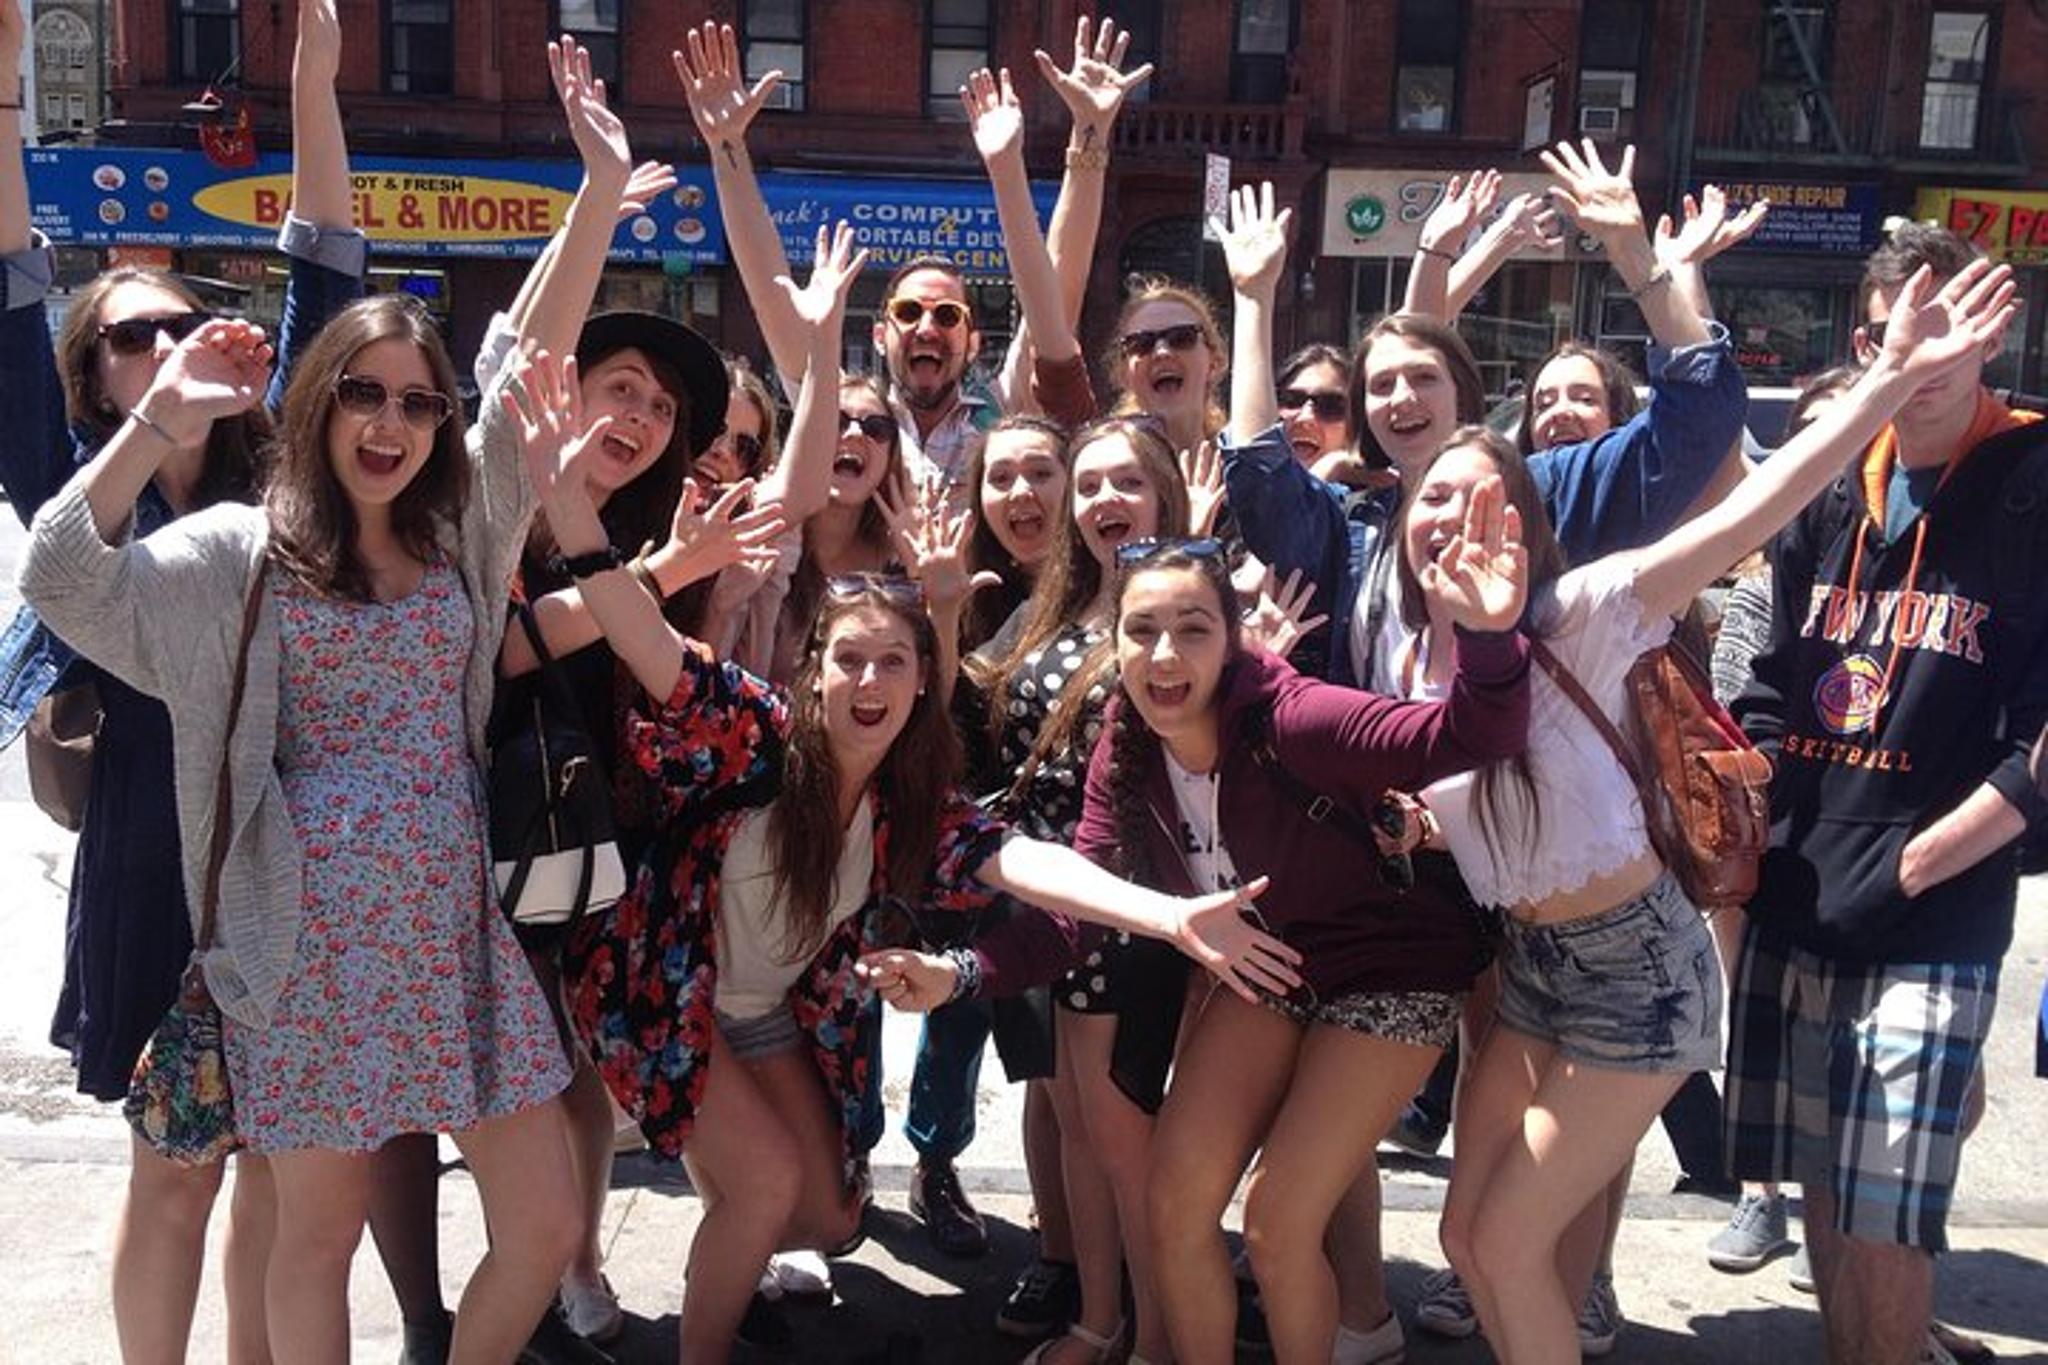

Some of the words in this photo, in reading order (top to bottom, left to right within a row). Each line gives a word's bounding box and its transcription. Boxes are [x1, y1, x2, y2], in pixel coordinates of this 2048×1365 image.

[349, 176, 378, 189] OT
[384, 177, 397, 190] &
[403, 178, 465, 193] FRESH
[1794, 186, 1846, 208] REPAIR
[31, 215, 70, 226] ELIVERY
[397, 193, 424, 229] &
[437, 195, 550, 232] MORE
[772, 200, 830, 225] ack's
[853, 203, 998, 224] COMPUT
[857, 227, 960, 248] ORTABLE
[1869, 590, 1990, 665] YORK
